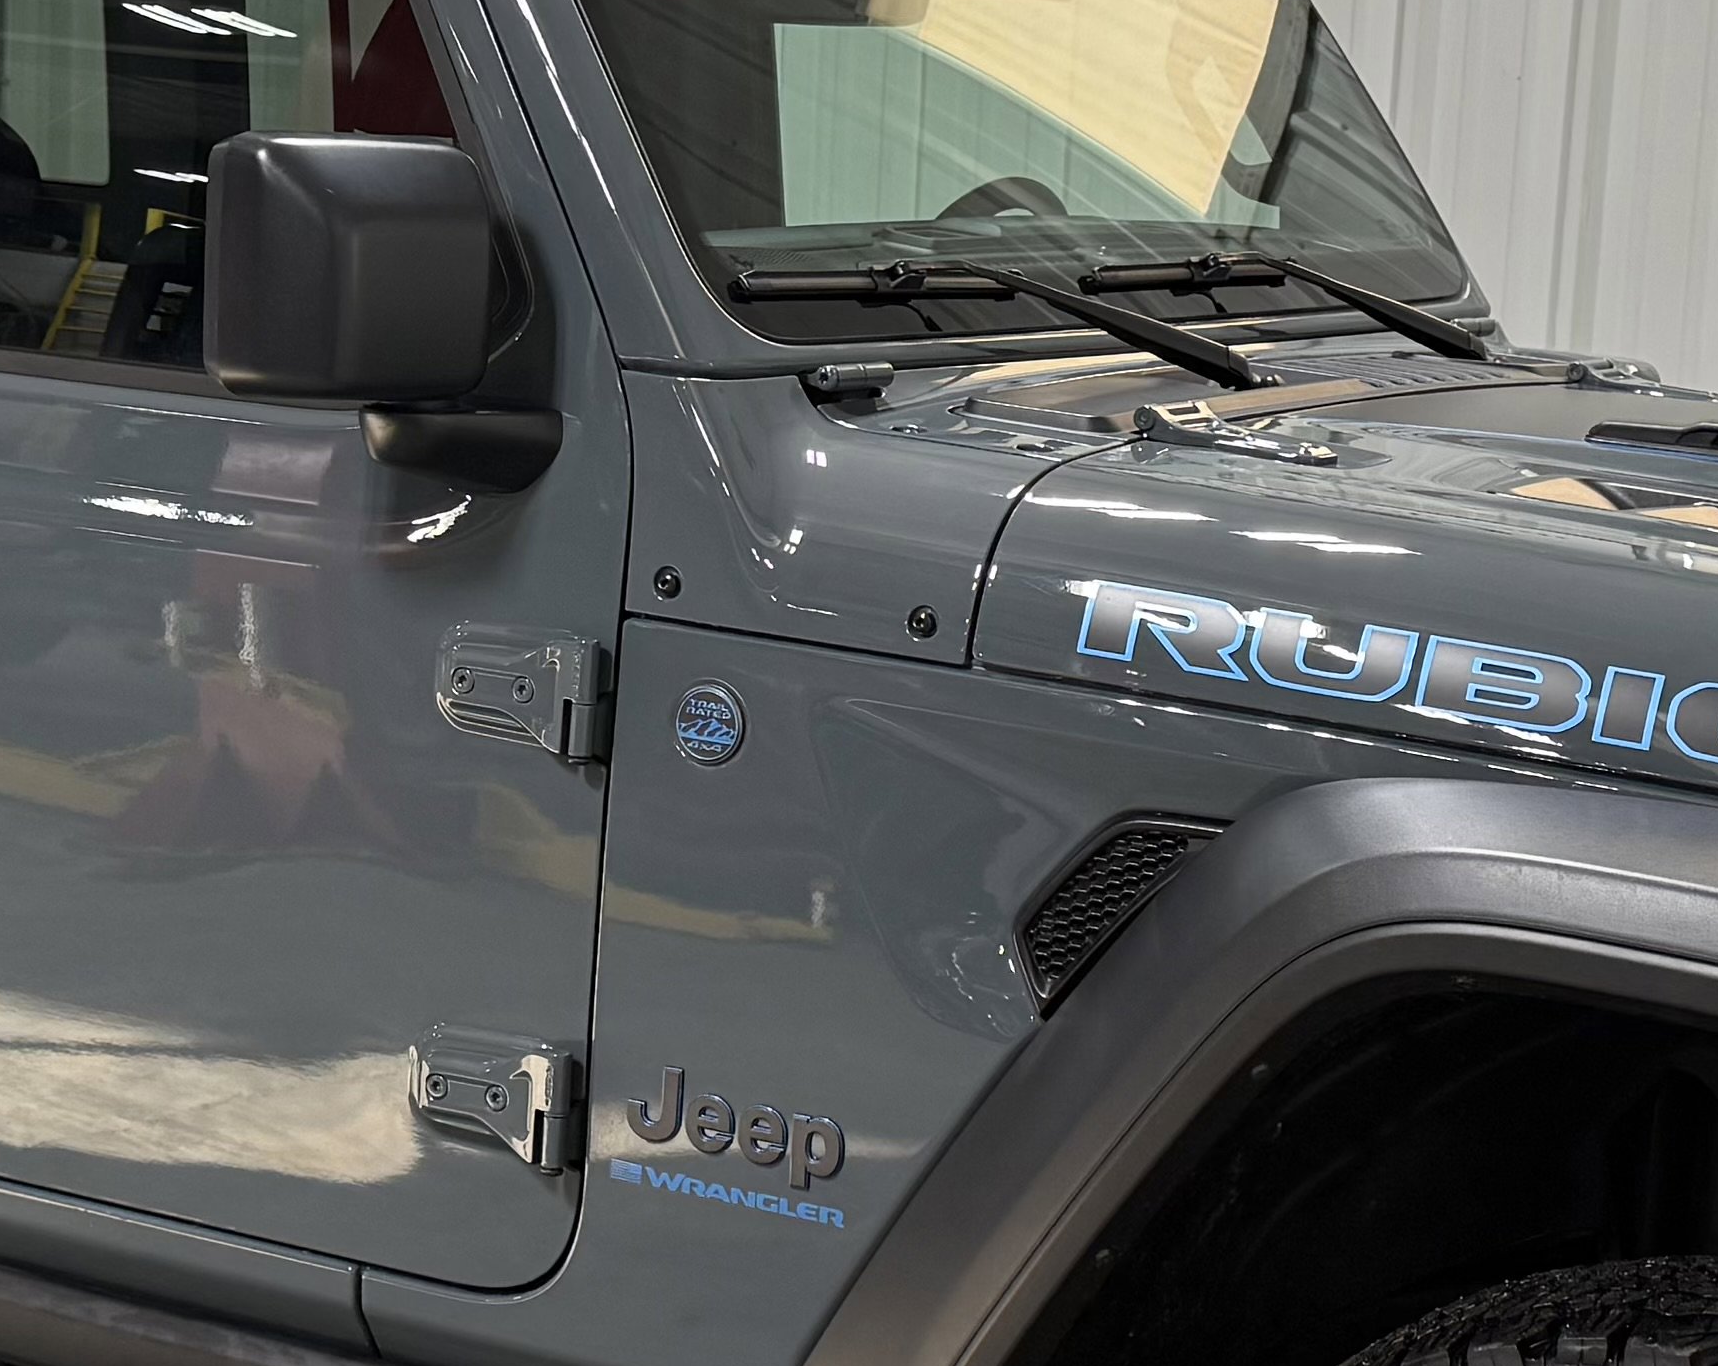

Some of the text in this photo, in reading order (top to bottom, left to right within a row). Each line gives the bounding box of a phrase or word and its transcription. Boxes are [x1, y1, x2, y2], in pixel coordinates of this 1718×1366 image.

[686, 706, 732, 720] RATED
[689, 698, 729, 713] TRAIL
[626, 1065, 846, 1191] Jeep
[644, 1166, 845, 1229] WRANGLER
